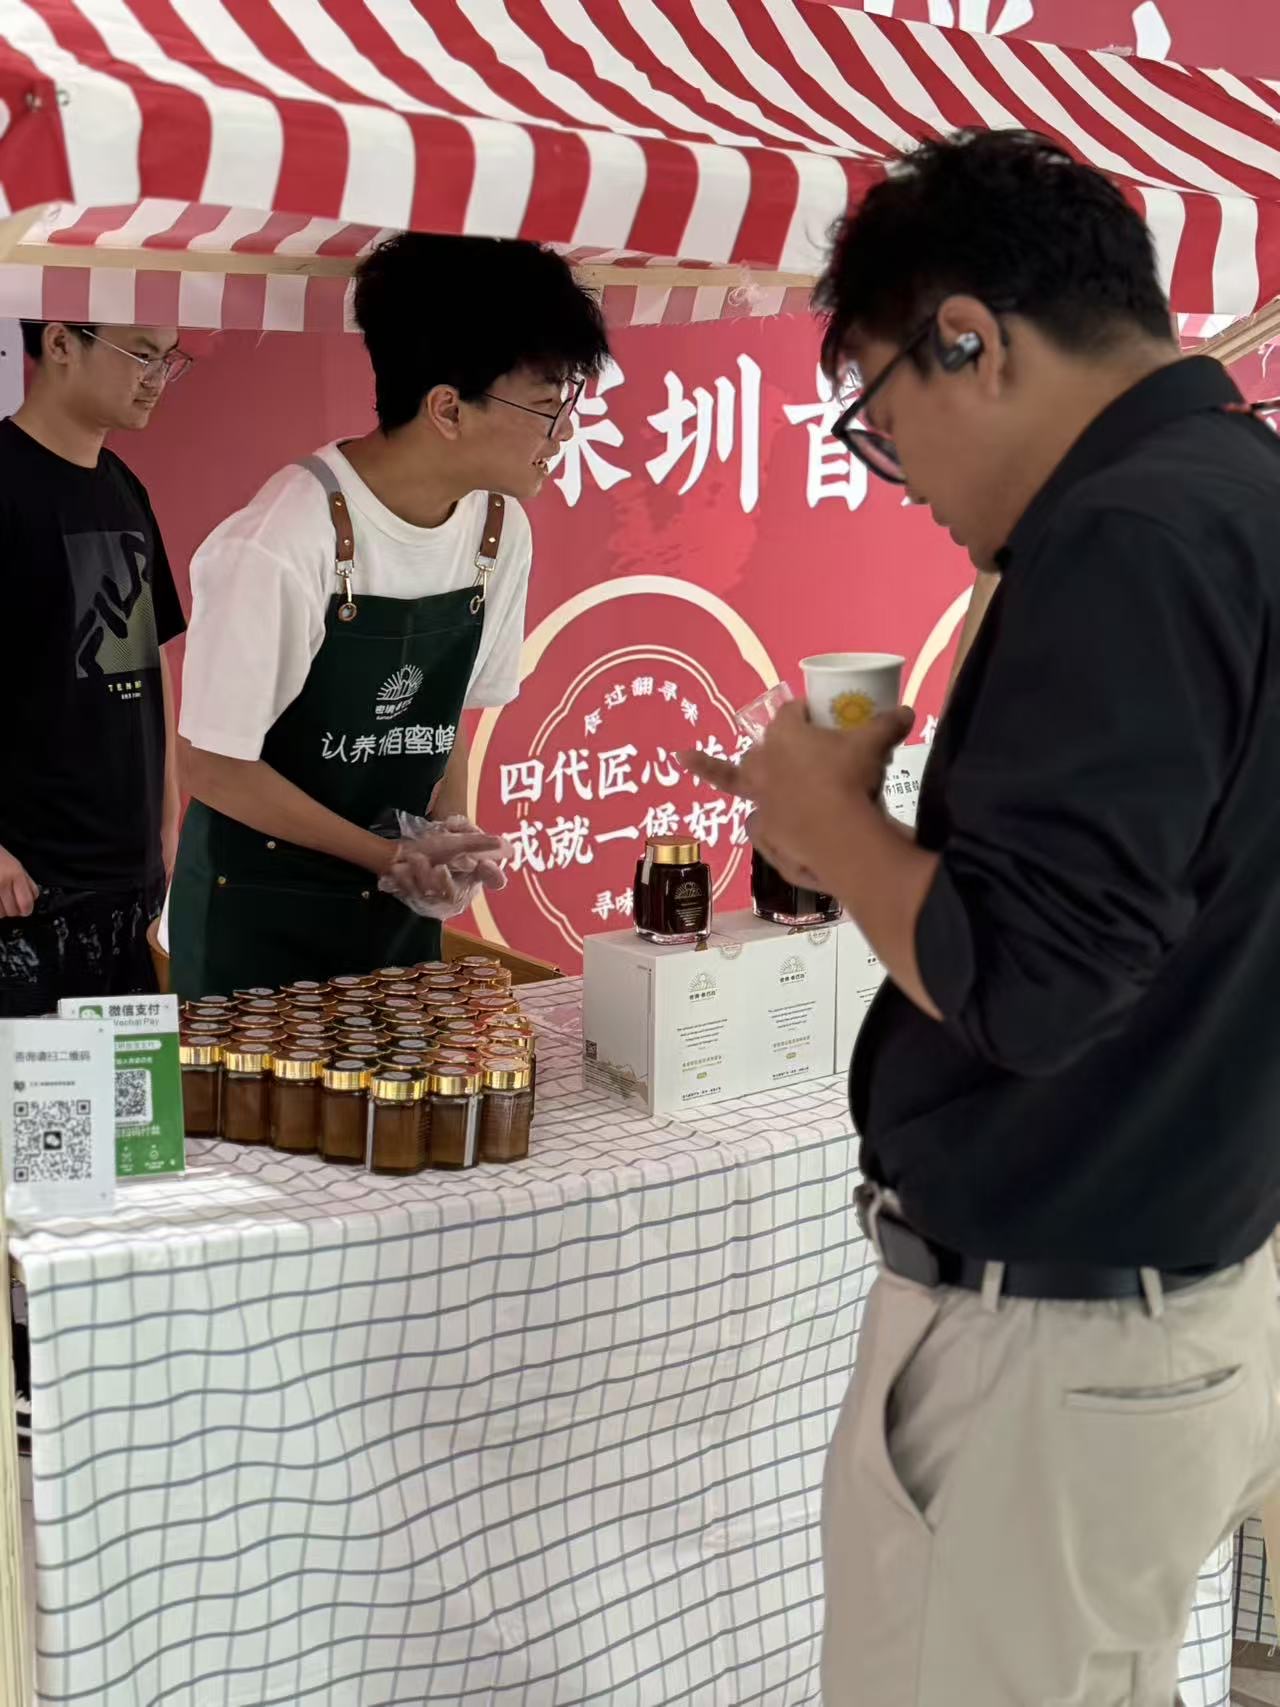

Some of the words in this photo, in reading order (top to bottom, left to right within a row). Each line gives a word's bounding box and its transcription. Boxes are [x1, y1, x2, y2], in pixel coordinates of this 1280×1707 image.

[548, 353, 920, 513] 深圳首
[108, 1003, 160, 1017] 微信支付
